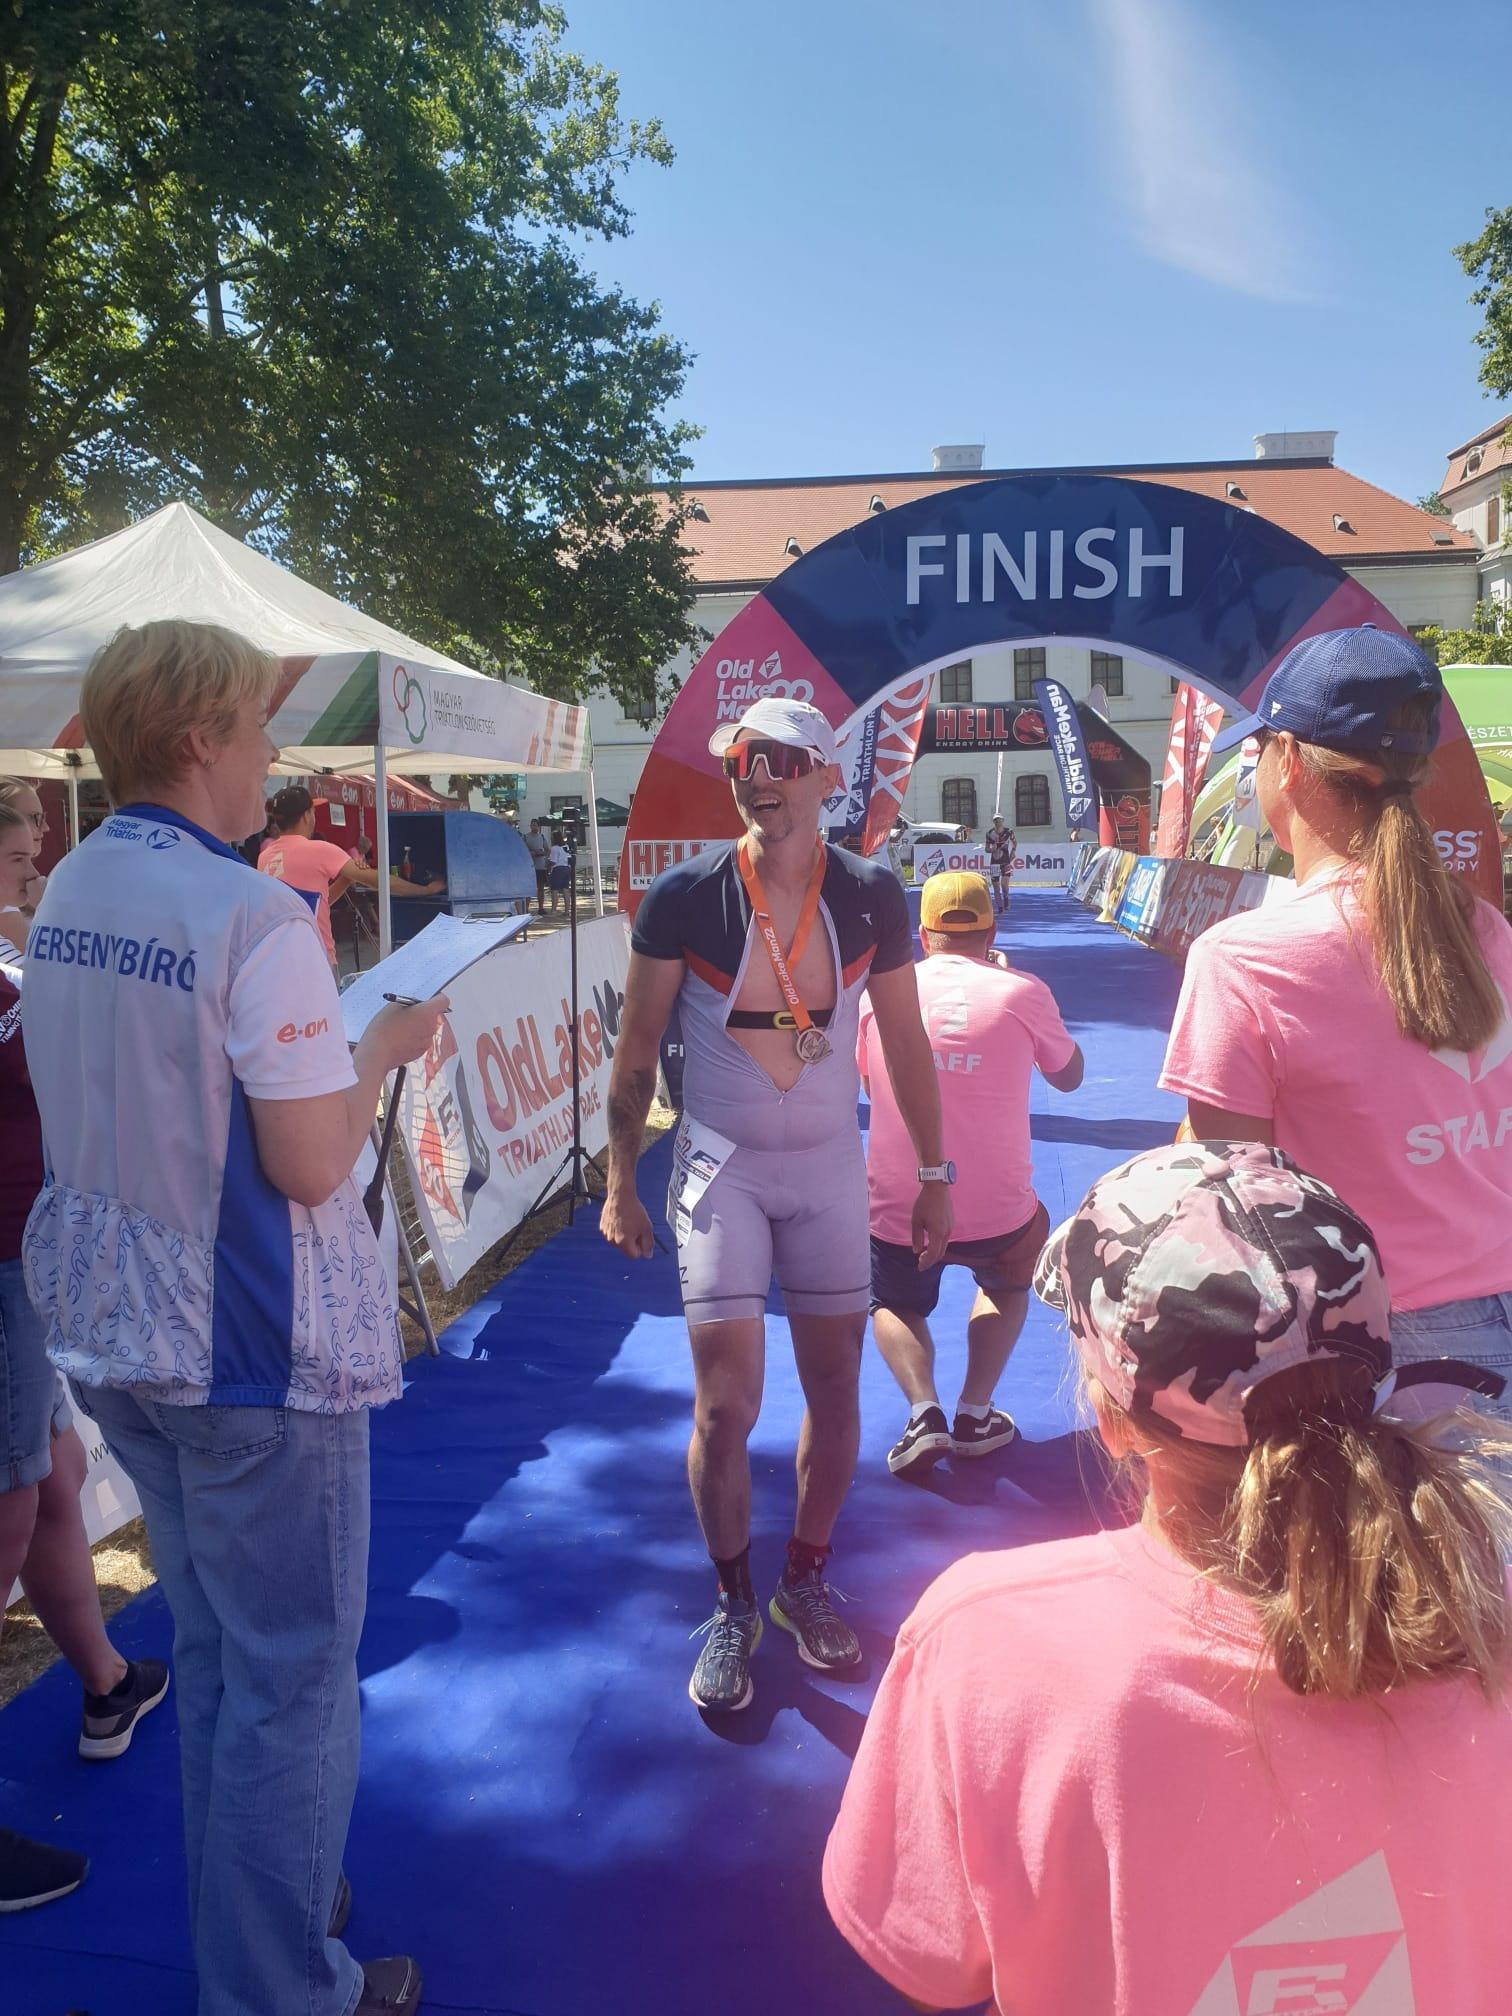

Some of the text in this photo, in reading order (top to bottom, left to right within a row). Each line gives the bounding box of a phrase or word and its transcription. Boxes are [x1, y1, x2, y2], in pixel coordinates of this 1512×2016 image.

[906, 526, 1185, 605] FINISH
[716, 660, 754, 679] Old
[716, 681, 772, 699] Lake
[433, 690, 463, 710] MAGYAR
[716, 701, 749, 720] Ma
[936, 708, 1009, 740] HELL
[1468, 726, 1512, 740] ÉSZE
[861, 720, 876, 783] TRIATHLON
[977, 739, 1009, 747] DRINK
[110, 818, 142, 829] Magyar
[105, 827, 142, 841] Triatlon
[1432, 830, 1478, 859] SS
[949, 854, 1065, 871] OldLeMan
[667, 1043, 684, 1057] FI
[932, 1053, 983, 1073] AFF
[1405, 1105, 1512, 1166] STAF
